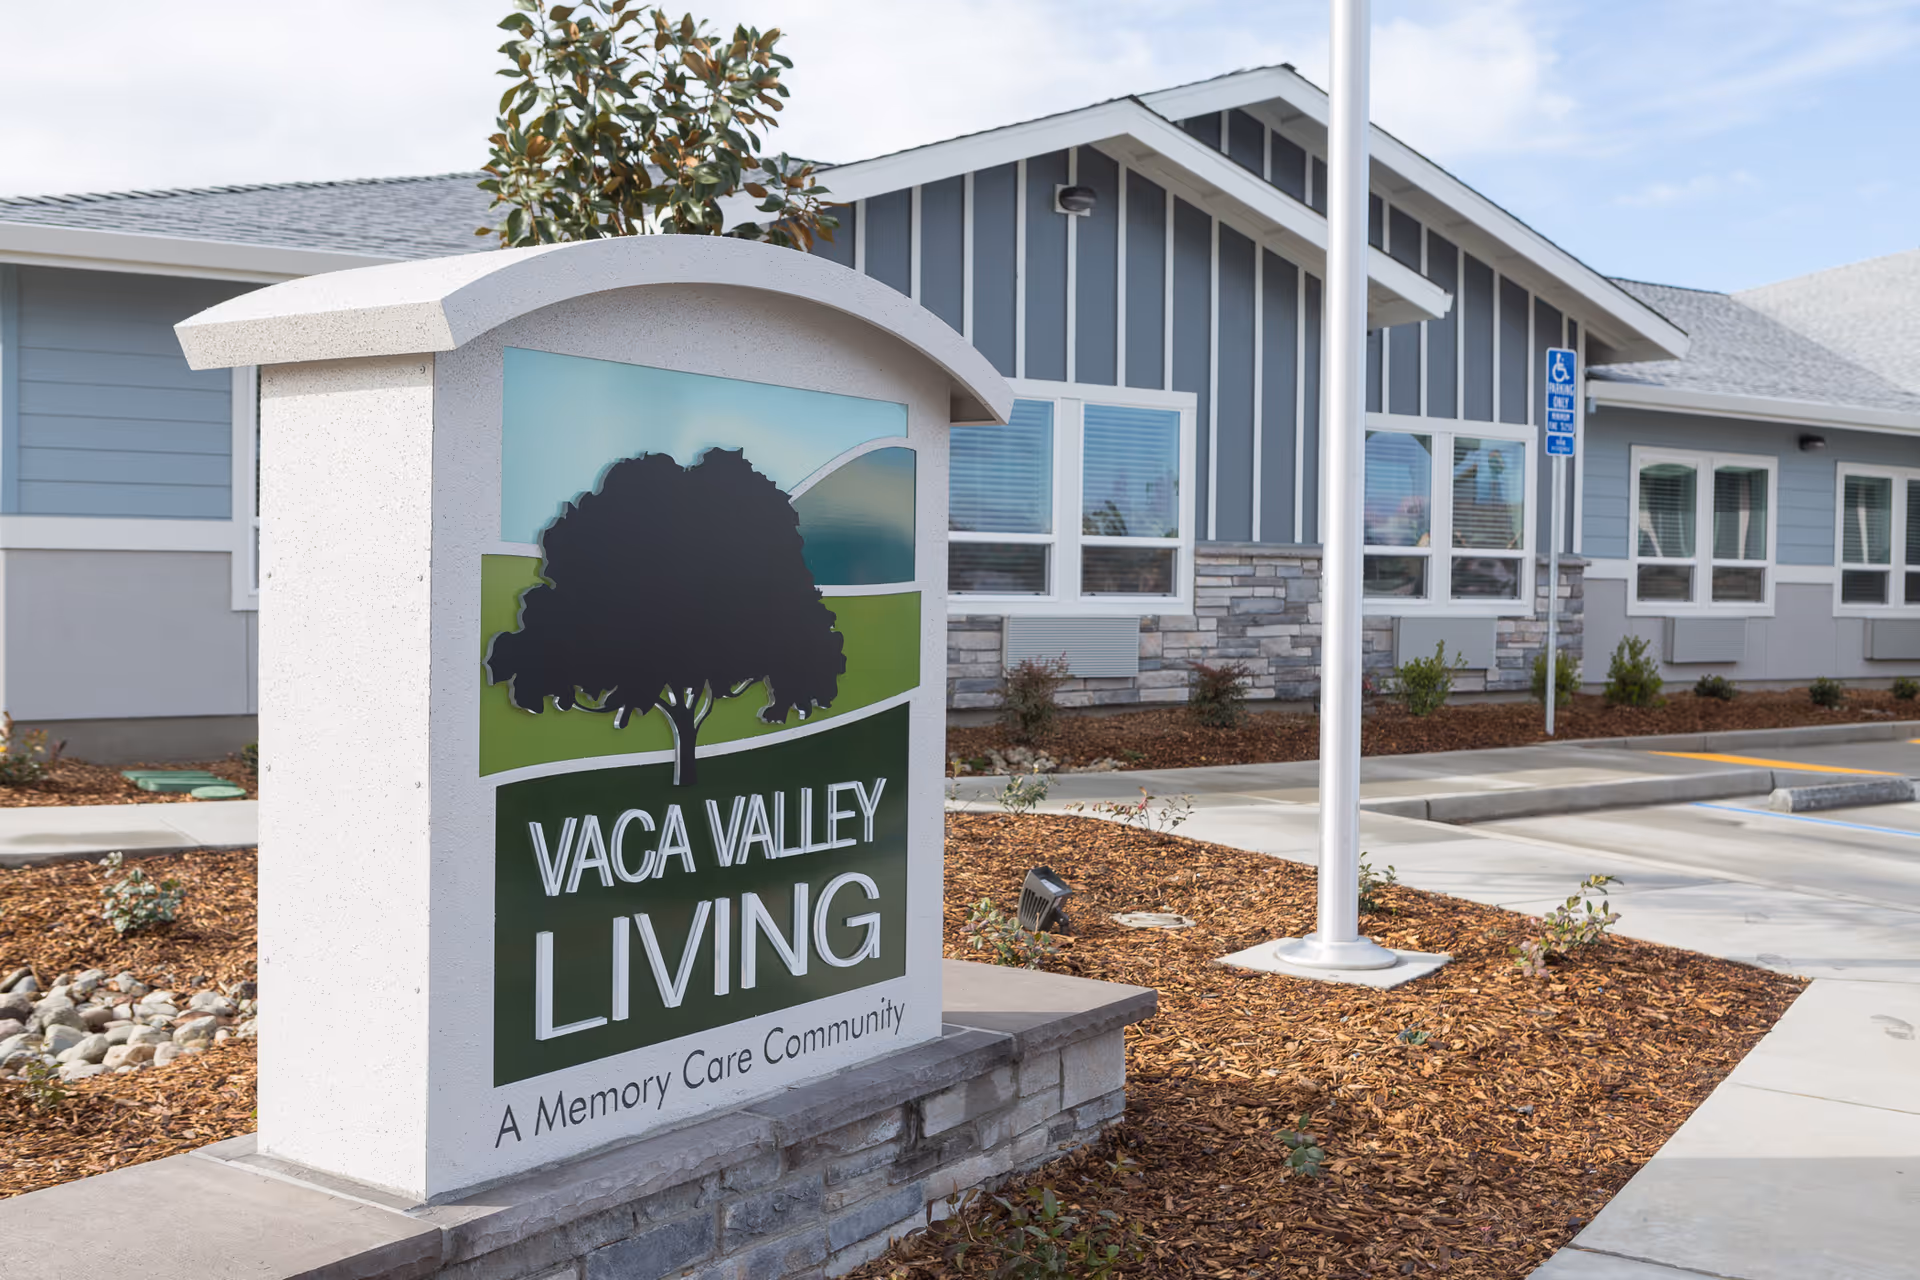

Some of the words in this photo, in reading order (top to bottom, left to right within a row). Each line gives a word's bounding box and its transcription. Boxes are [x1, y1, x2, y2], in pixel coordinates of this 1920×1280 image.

[1549, 382, 1574, 396] PARKING
[1553, 396, 1569, 408] ONLY
[528, 804, 696, 897] VACA
[705, 777, 887, 867] VALLEY
[535, 871, 881, 1041] LIVING
[495, 1104, 522, 1148] A
[534, 1071, 672, 1137] Memory
[682, 1047, 753, 1089] Care
[763, 996, 906, 1064] Community
